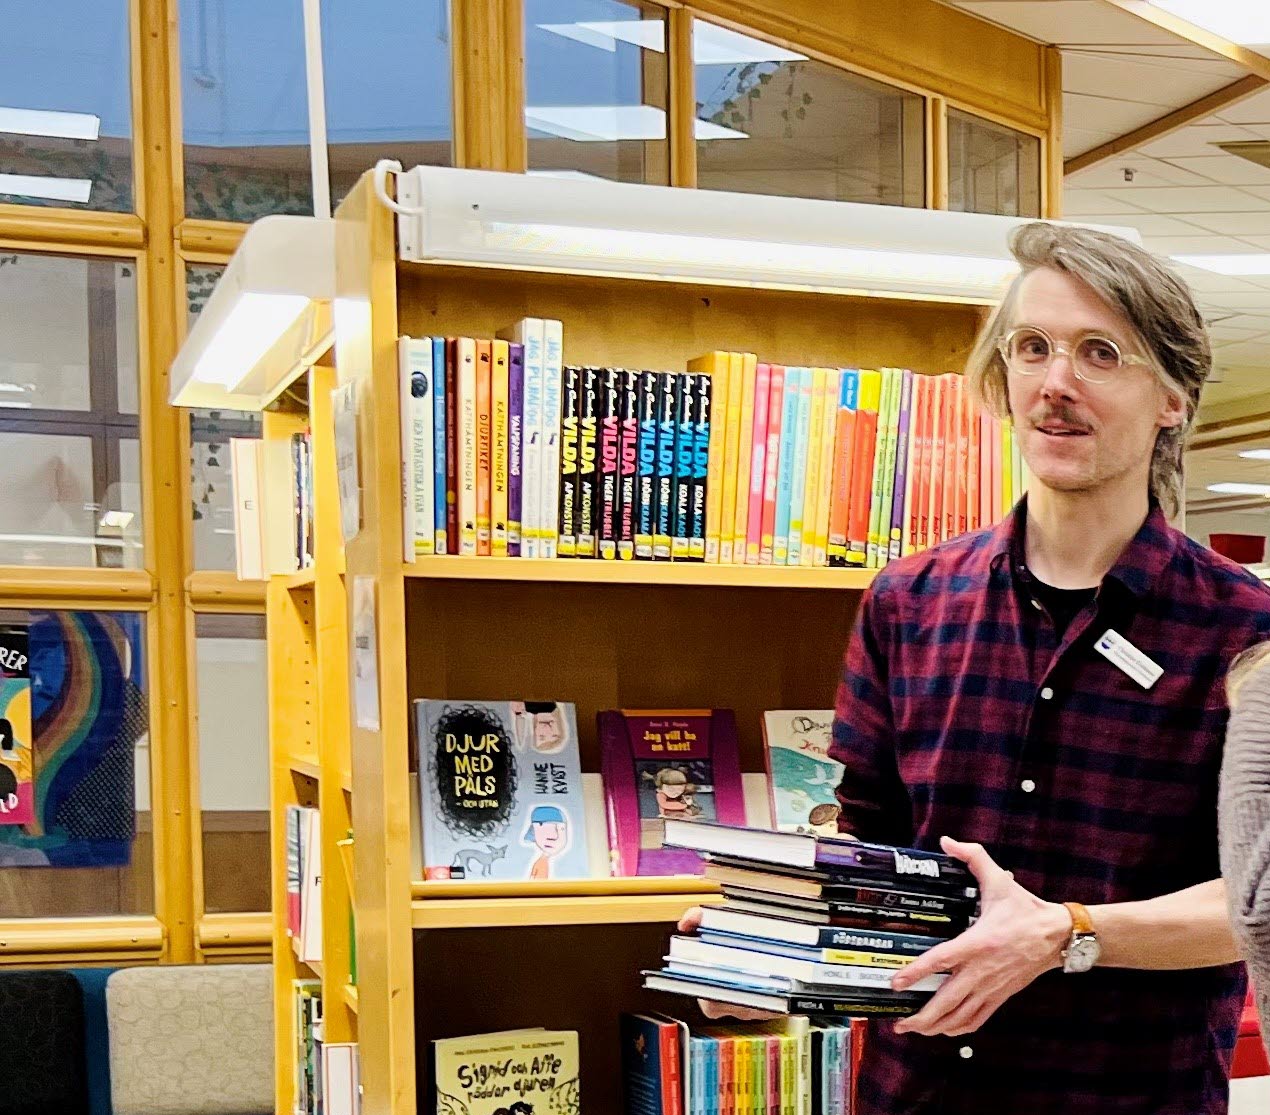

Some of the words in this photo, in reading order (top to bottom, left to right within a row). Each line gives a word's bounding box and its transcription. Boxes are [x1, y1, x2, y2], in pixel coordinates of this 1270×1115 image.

[562, 416, 577, 474] VILDA
[581, 416, 596, 474] VILDA
[602, 416, 618, 473] VILDA
[622, 418, 637, 475] VILDA
[640, 419, 656, 475] VILDA
[659, 420, 674, 477] VILDA
[678, 421, 693, 478] VILDA
[694, 422, 709, 478] VILDA
[445, 733, 500, 755] DJUR
[454, 755, 493, 774] MED
[454, 773, 497, 797] PÄLS
[457, 1058, 513, 1088] Sigrid
